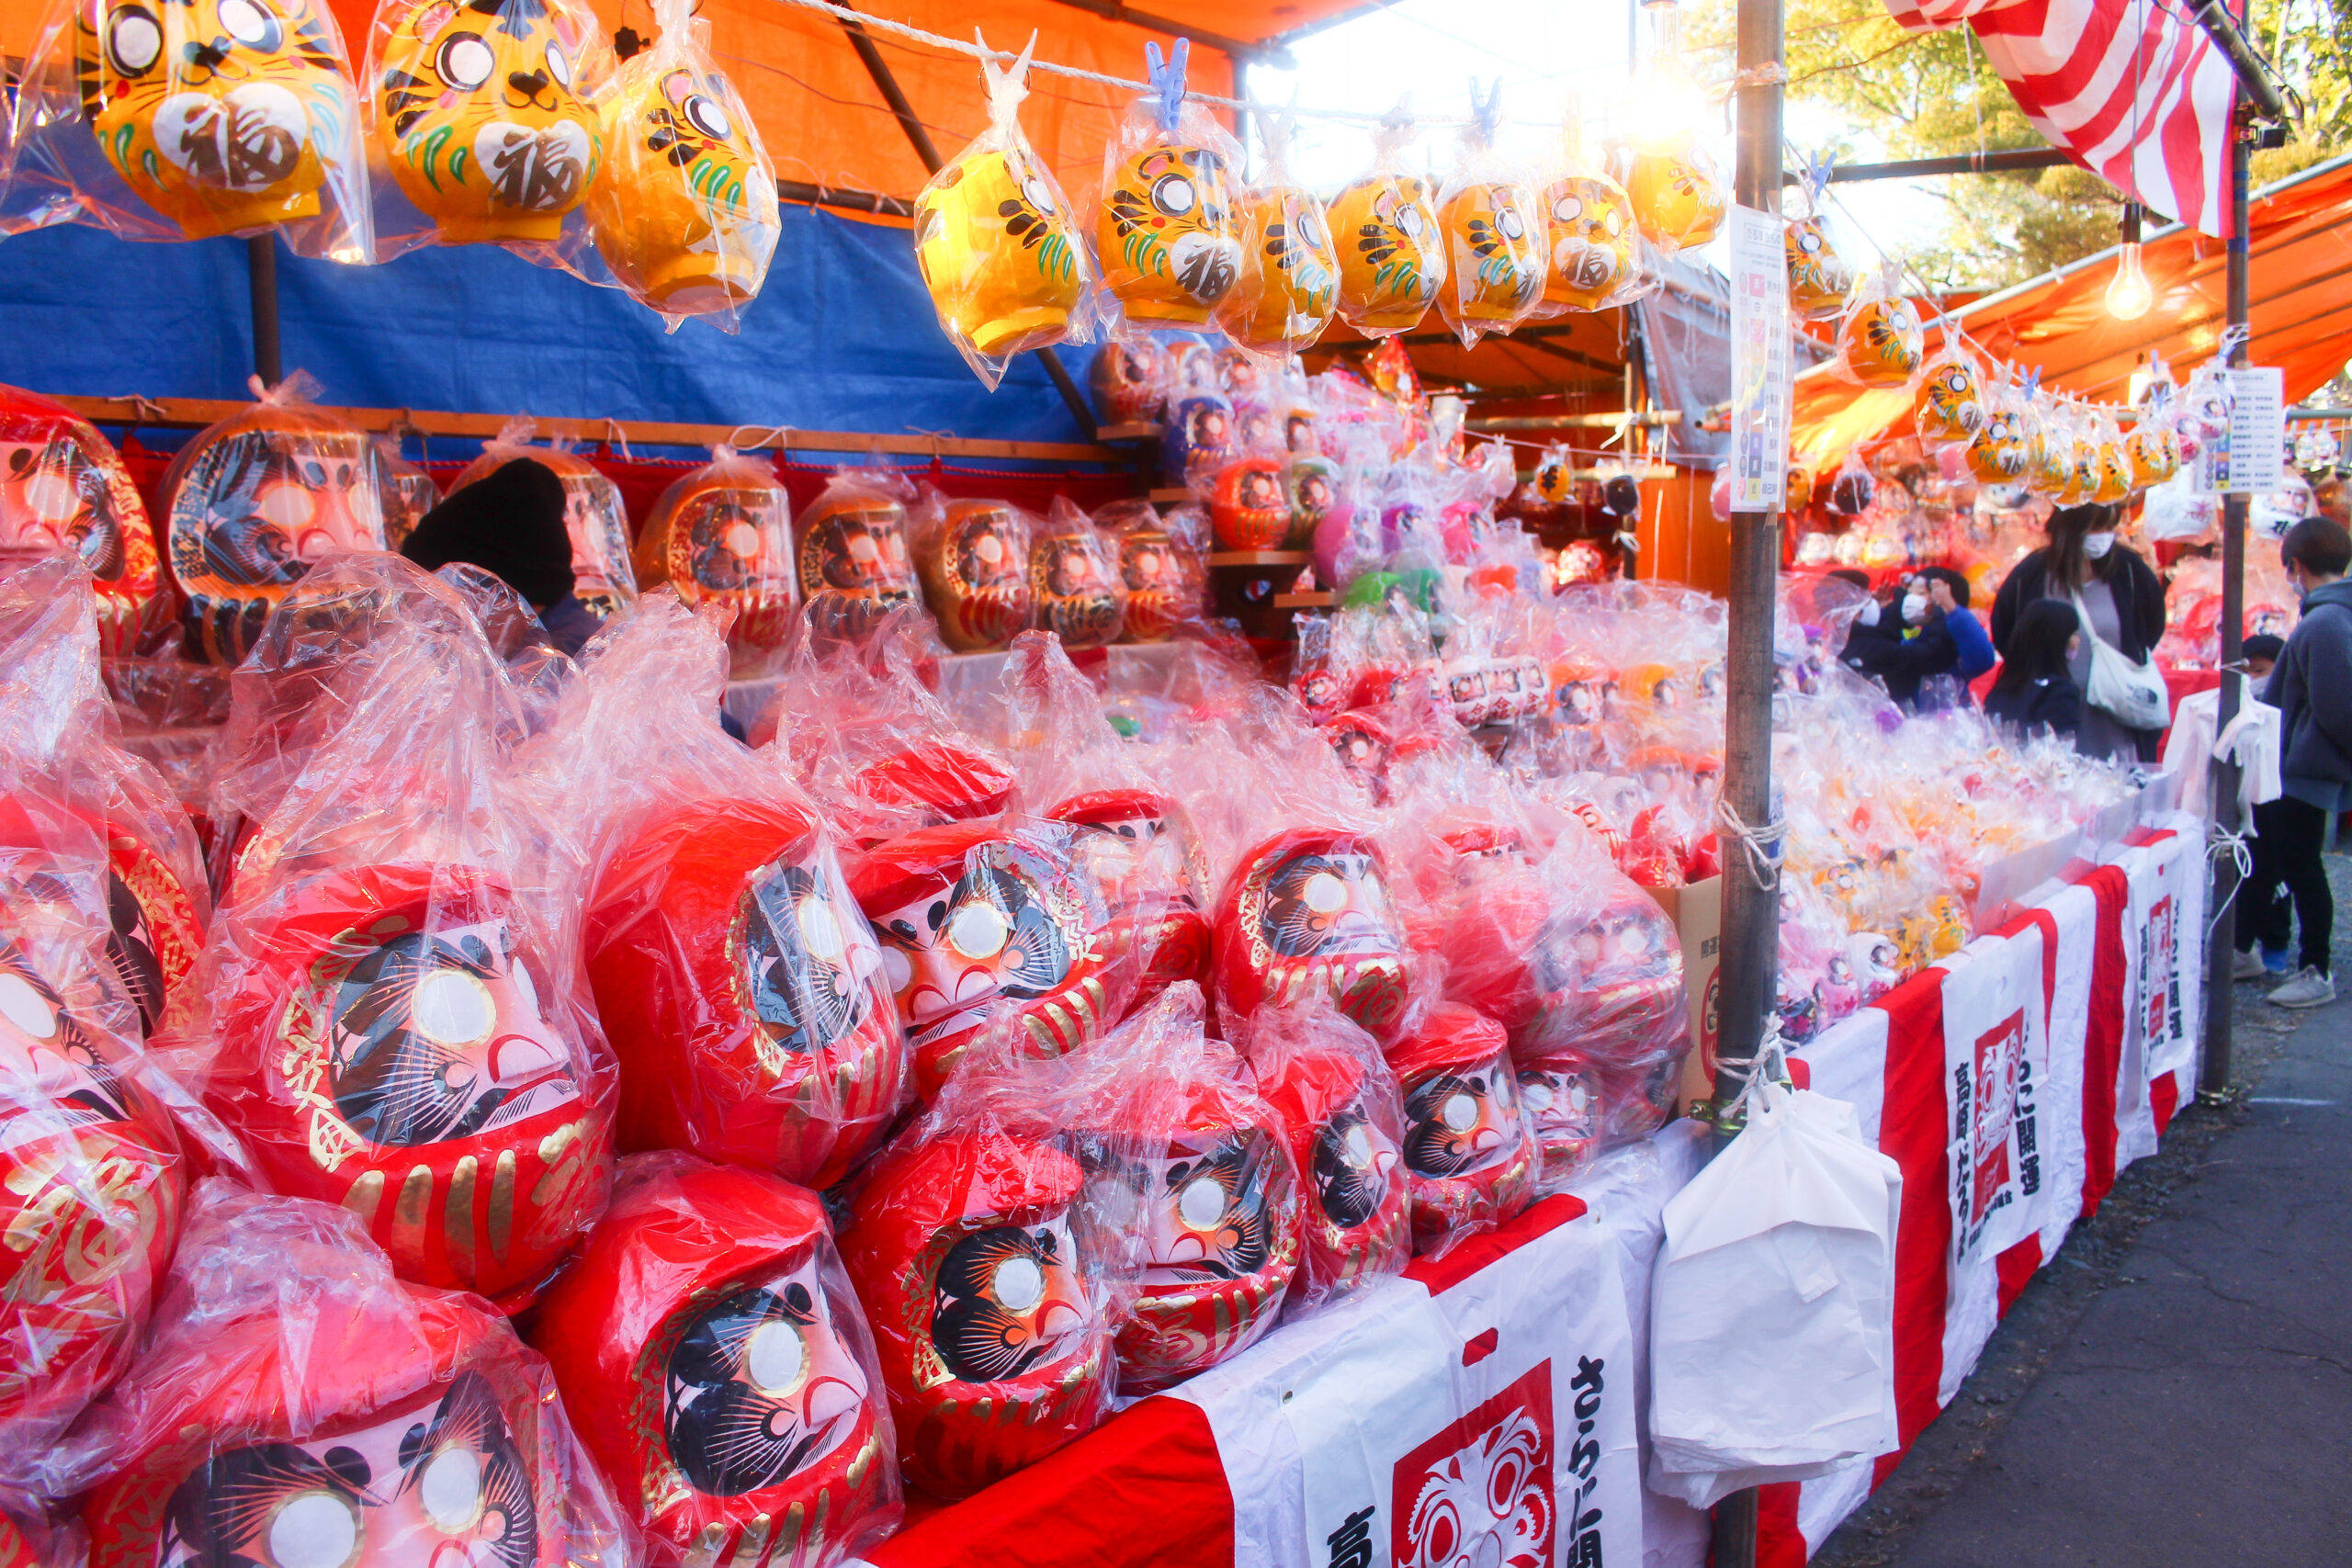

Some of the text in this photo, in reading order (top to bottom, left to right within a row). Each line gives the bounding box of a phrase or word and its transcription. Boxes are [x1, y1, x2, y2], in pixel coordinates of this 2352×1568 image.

[181, 99, 301, 191] 福
[489, 130, 584, 210] 福
[1176, 243, 1236, 302] 福
